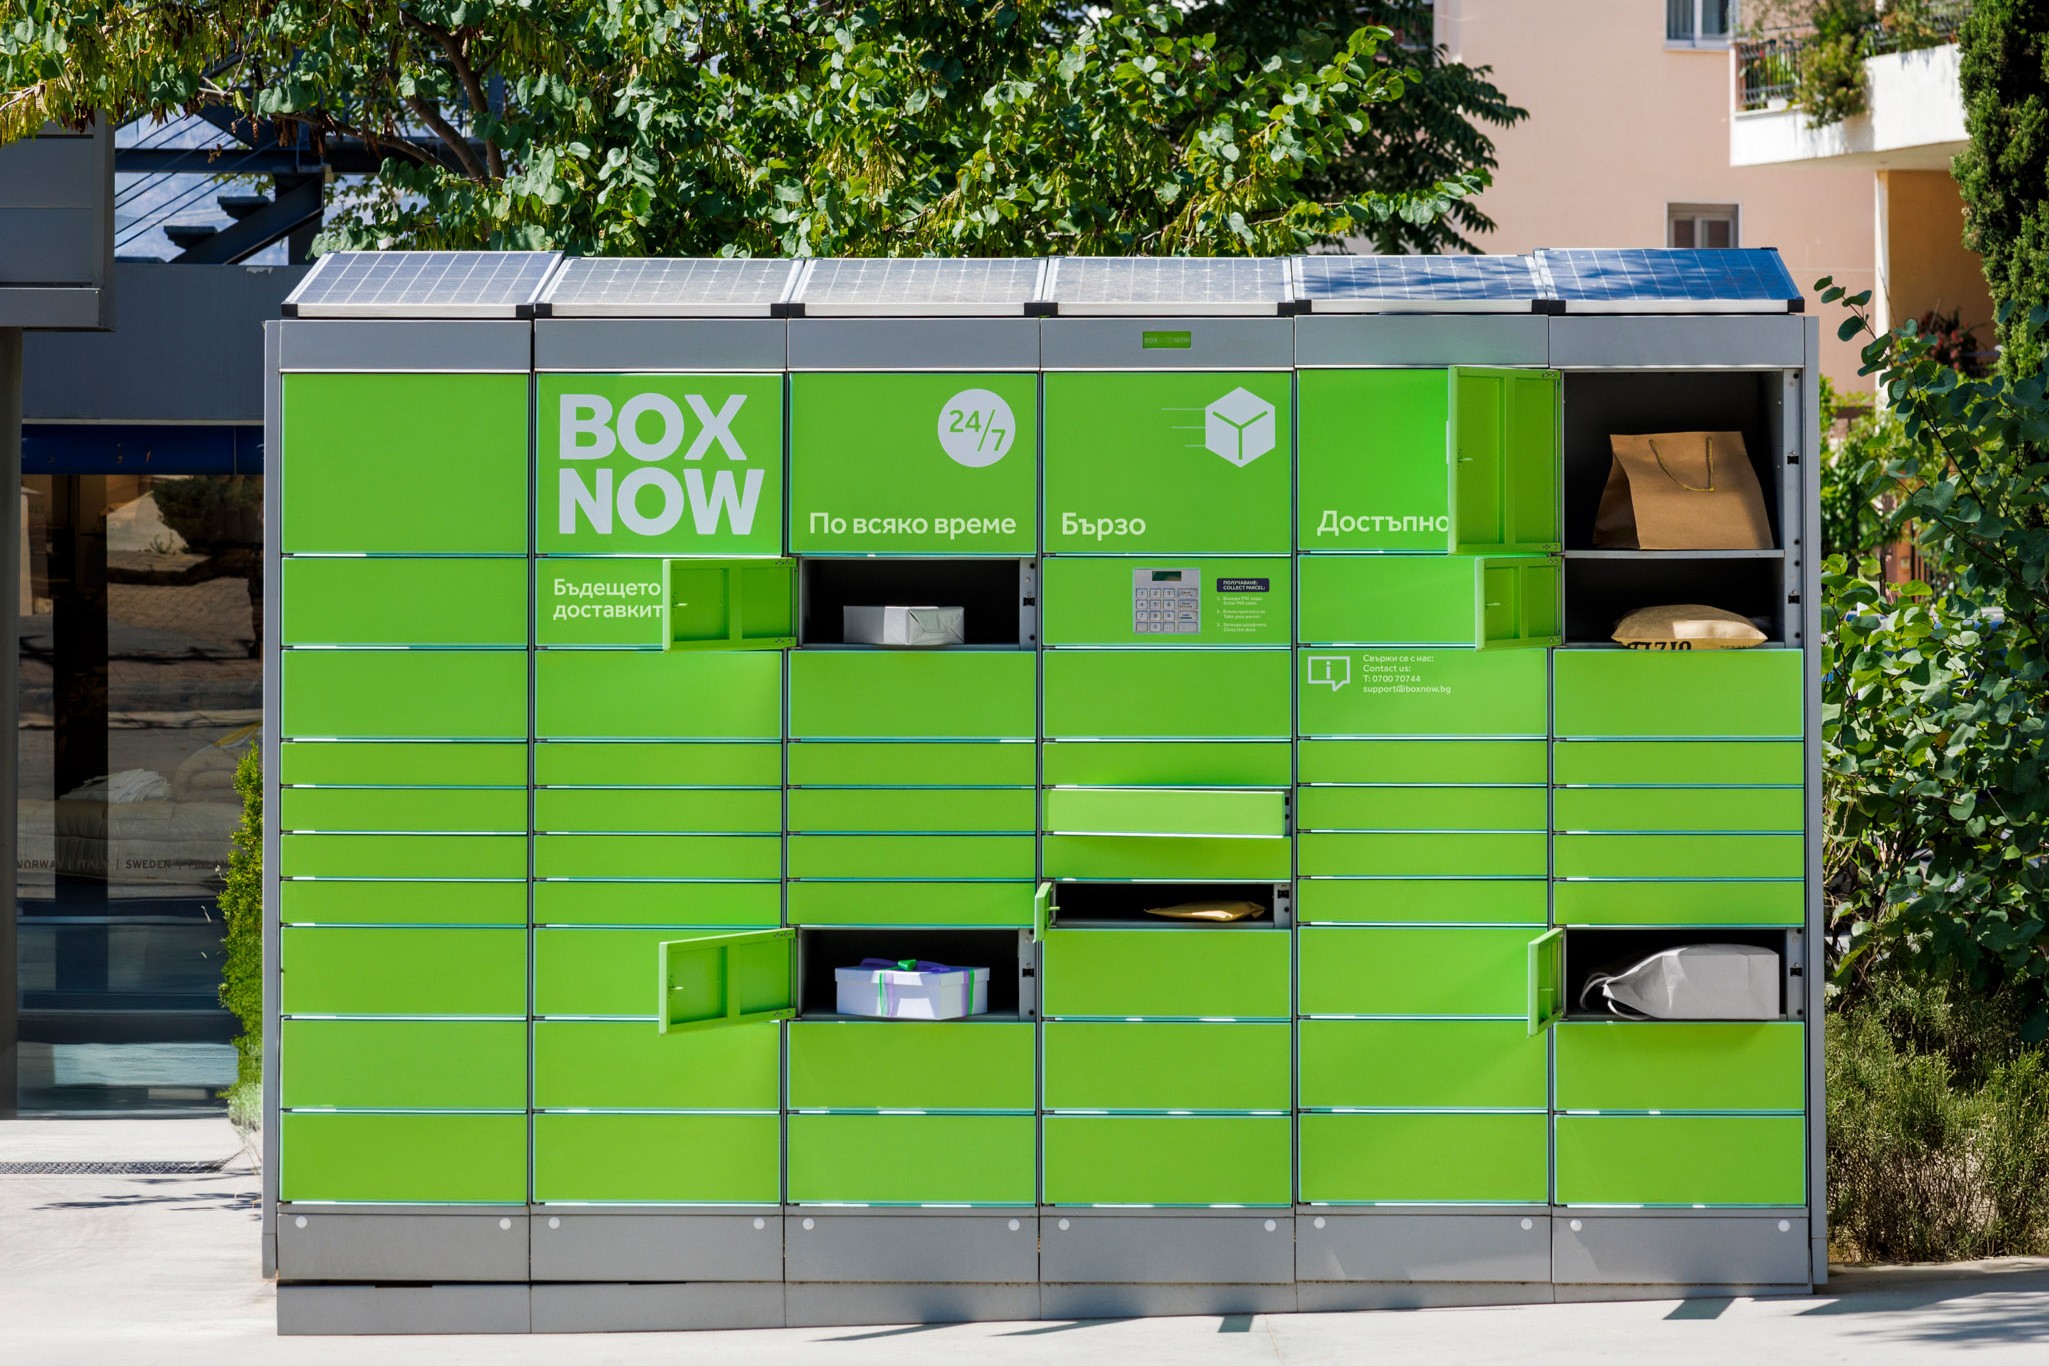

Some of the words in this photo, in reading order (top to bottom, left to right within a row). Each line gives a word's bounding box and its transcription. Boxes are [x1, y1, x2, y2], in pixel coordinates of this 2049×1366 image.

[559, 392, 748, 462] BOX
[949, 409, 1007, 452] 24/7
[558, 466, 765, 536] NOW
[809, 512, 847, 535] По
[853, 517, 929, 535] всяко
[934, 517, 1017, 540] време
[1062, 512, 1147, 541] Бързо
[1316, 510, 1449, 537] Достъпно
[553, 578, 661, 598] Бъдещето
[1363, 654, 1398, 664] Свържи
[1363, 664, 1397, 672] Contact
[1363, 685, 1451, 694] support@boxnow.bg
[1372, 675, 1394, 683] 0700
[1395, 675, 1421, 683] 70744
[126, 860, 171, 869] SWEDEN
